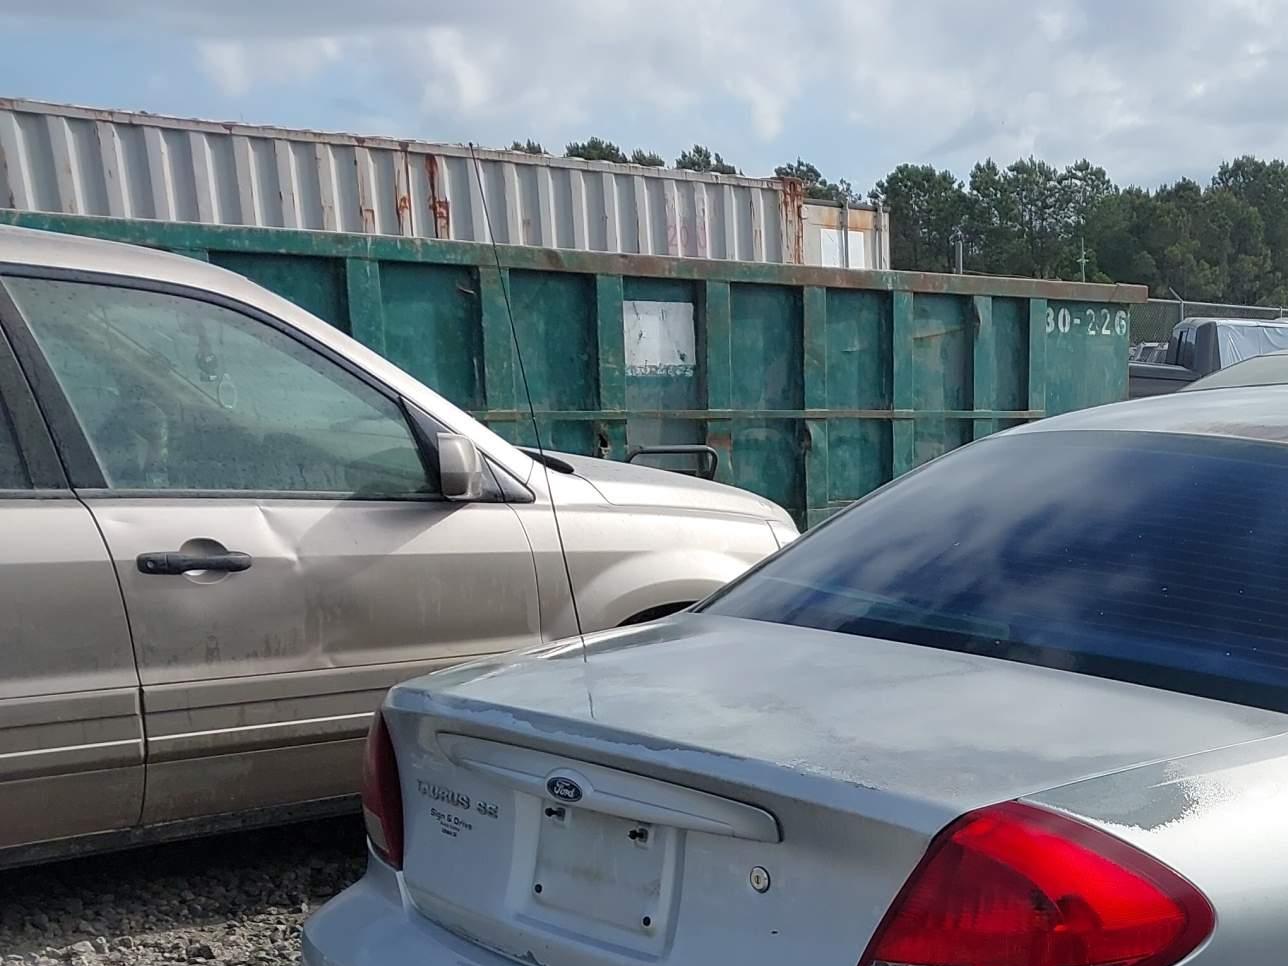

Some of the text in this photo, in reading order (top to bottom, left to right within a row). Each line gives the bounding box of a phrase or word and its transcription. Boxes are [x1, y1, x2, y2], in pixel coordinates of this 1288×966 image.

[1045, 307, 1127, 336] 30-226
[416, 779, 499, 820] TAURUS SE
